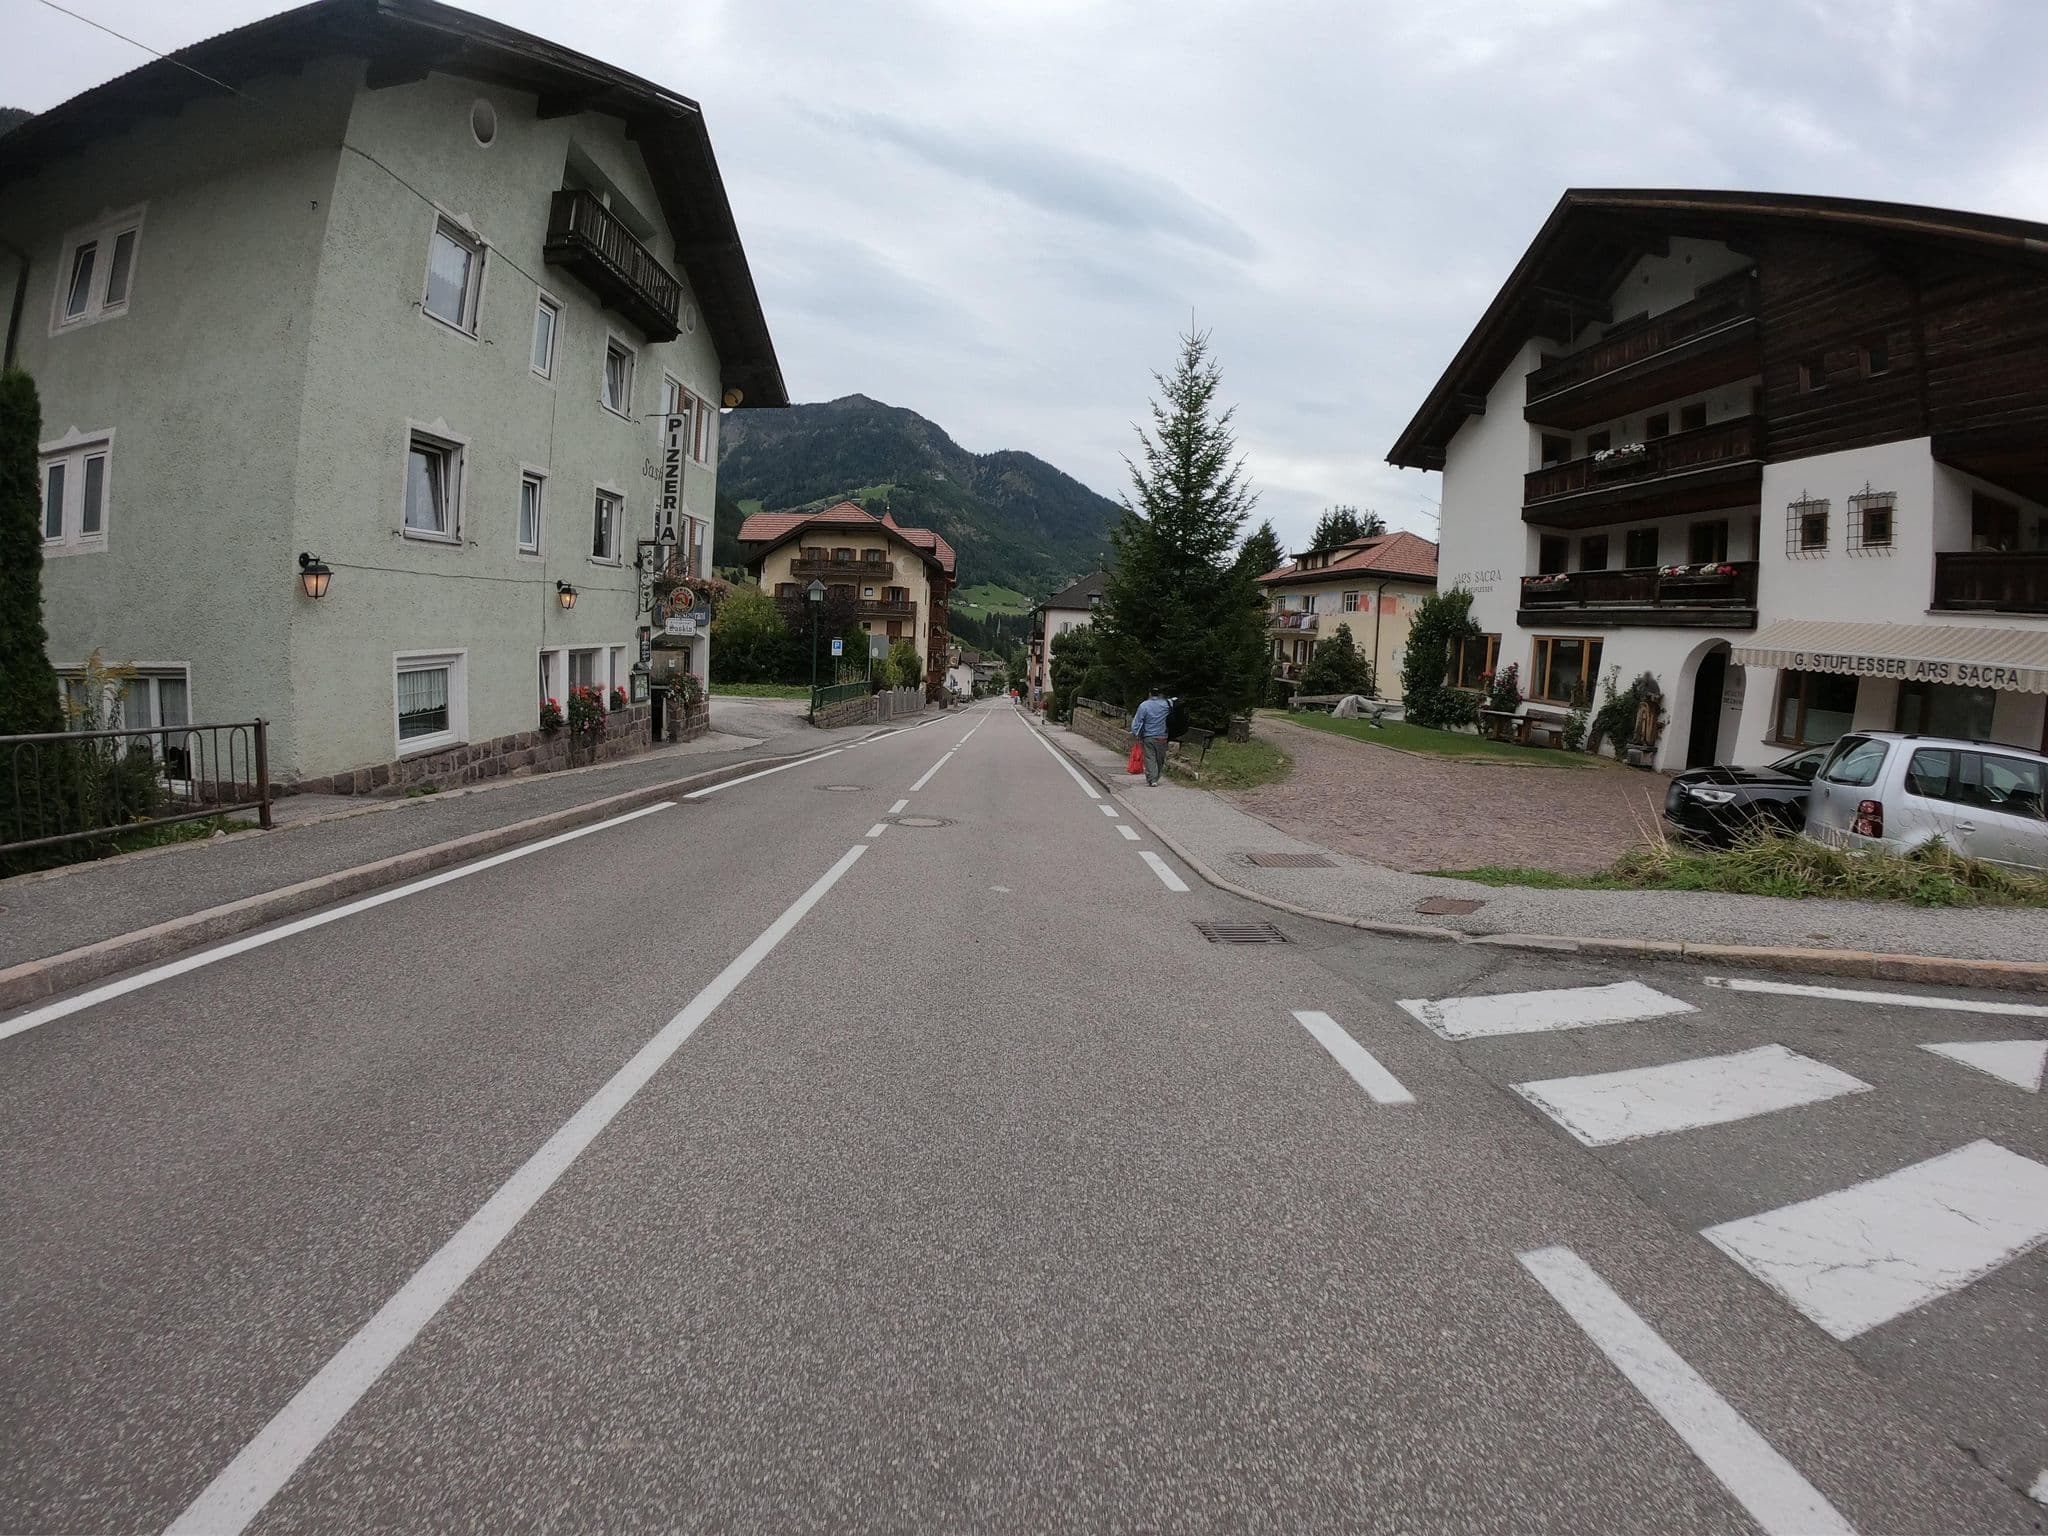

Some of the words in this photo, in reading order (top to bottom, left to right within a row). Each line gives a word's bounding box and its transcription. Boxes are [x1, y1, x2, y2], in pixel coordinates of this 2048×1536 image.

[661, 418, 682, 541] PIZZERIA
[1474, 568, 1502, 583] SACRA
[1795, 653, 1807, 667] G.
[1813, 654, 1906, 675] STUFLESSER
[1915, 661, 1949, 679] ARS
[1958, 665, 2019, 686] SACRA
